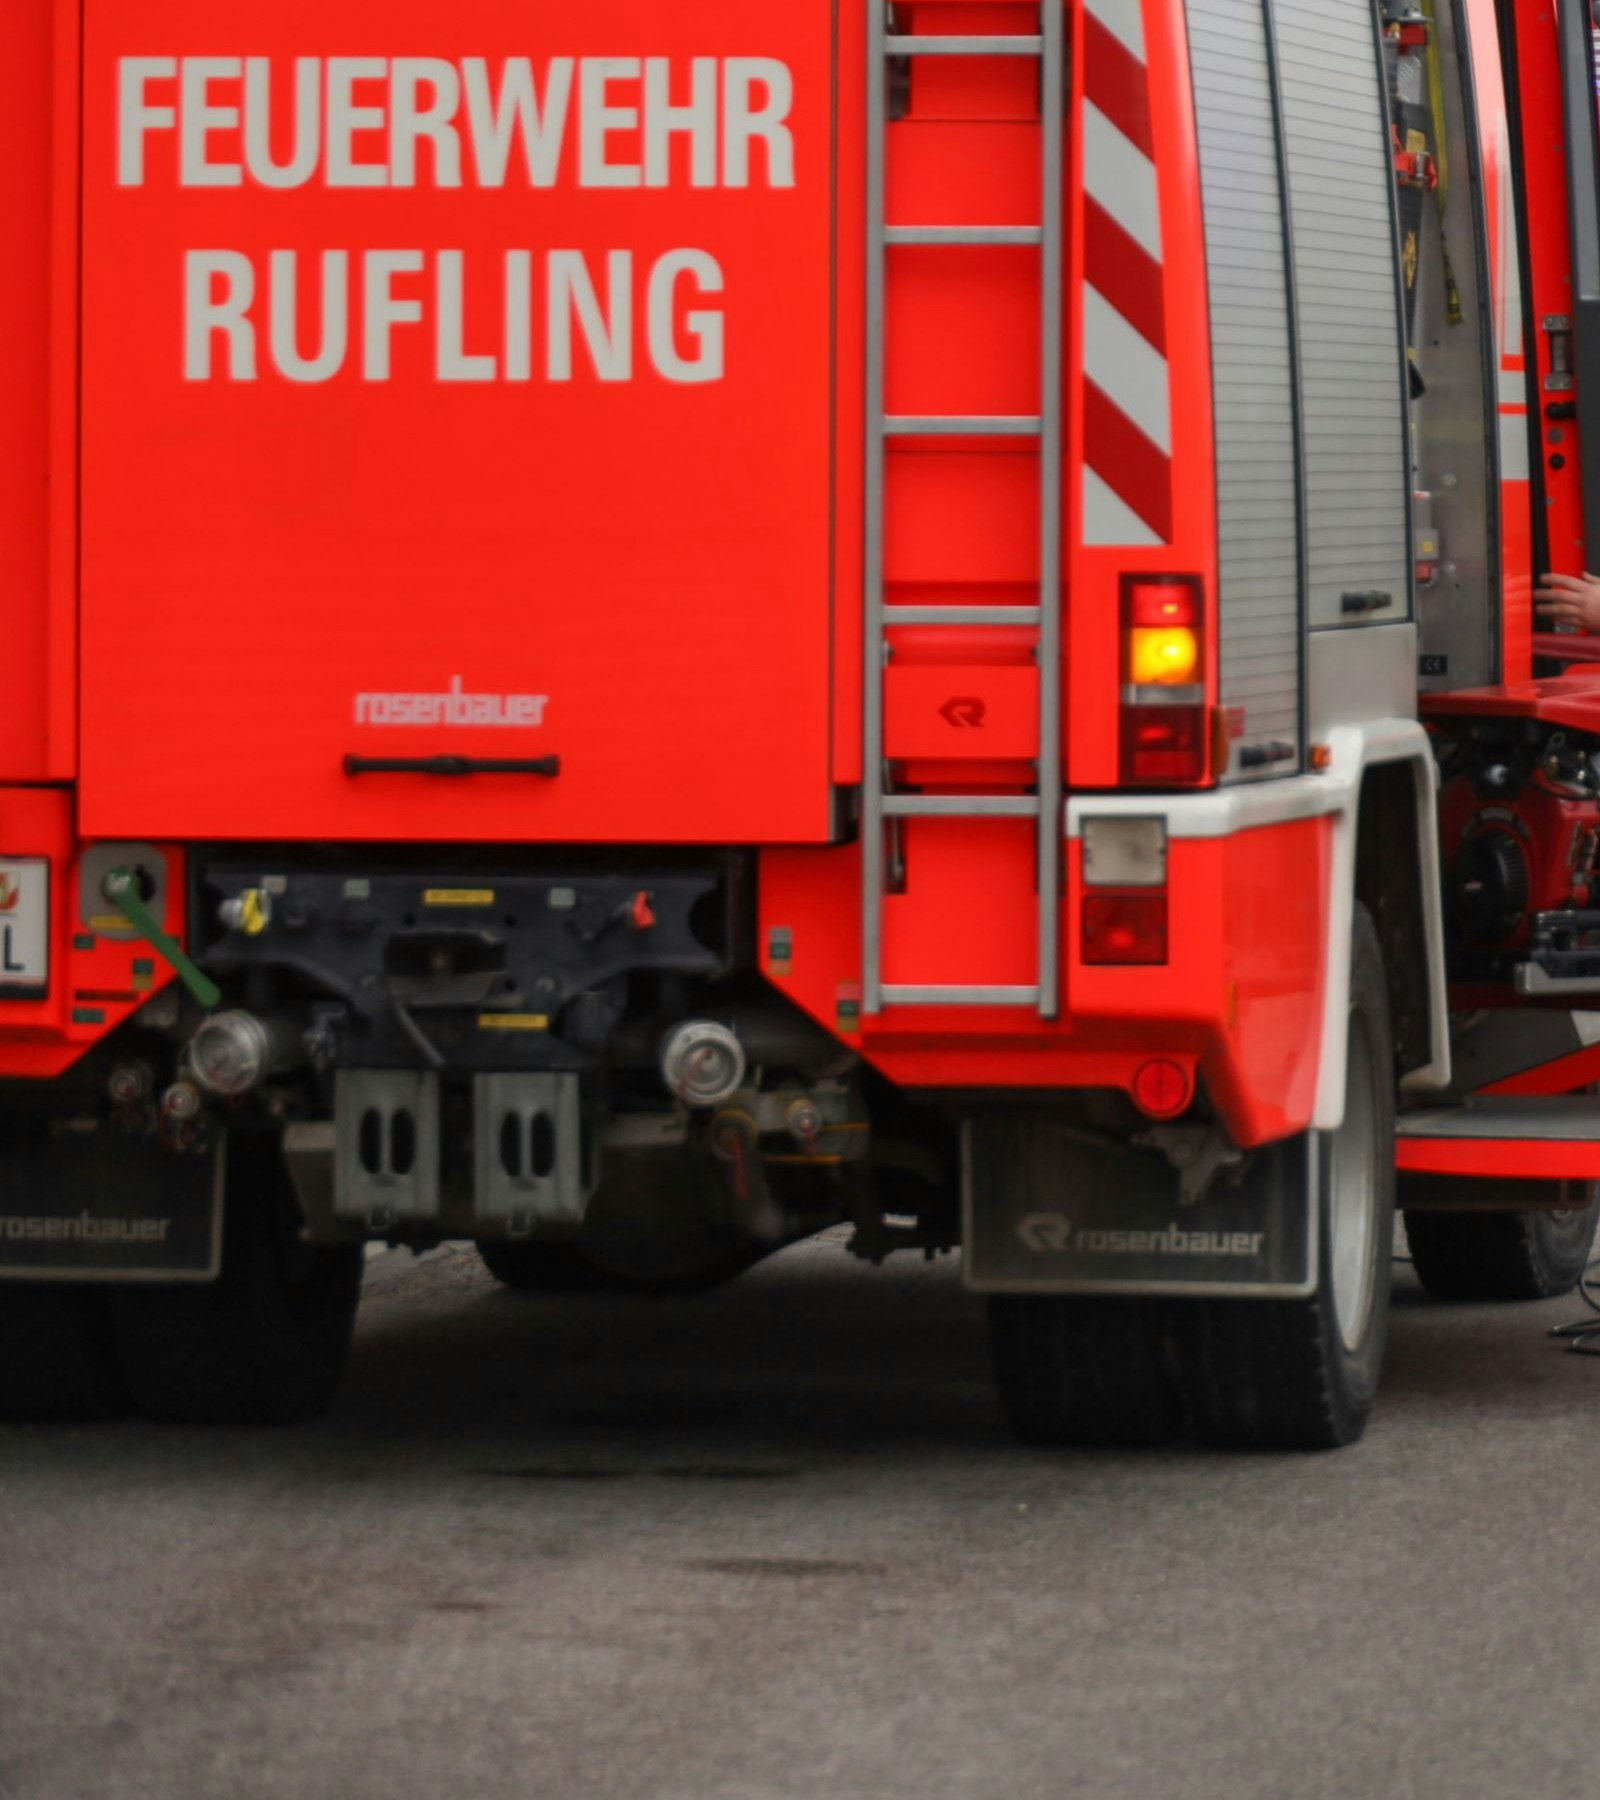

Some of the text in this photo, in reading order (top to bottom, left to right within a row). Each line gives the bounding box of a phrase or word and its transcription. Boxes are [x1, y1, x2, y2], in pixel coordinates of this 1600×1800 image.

[116, 56, 796, 189] FEUERWEHR
[183, 248, 724, 384] RUFLING
[355, 674, 550, 726] rosenbauer
[1077, 1222, 1264, 1254] rosenbauer
